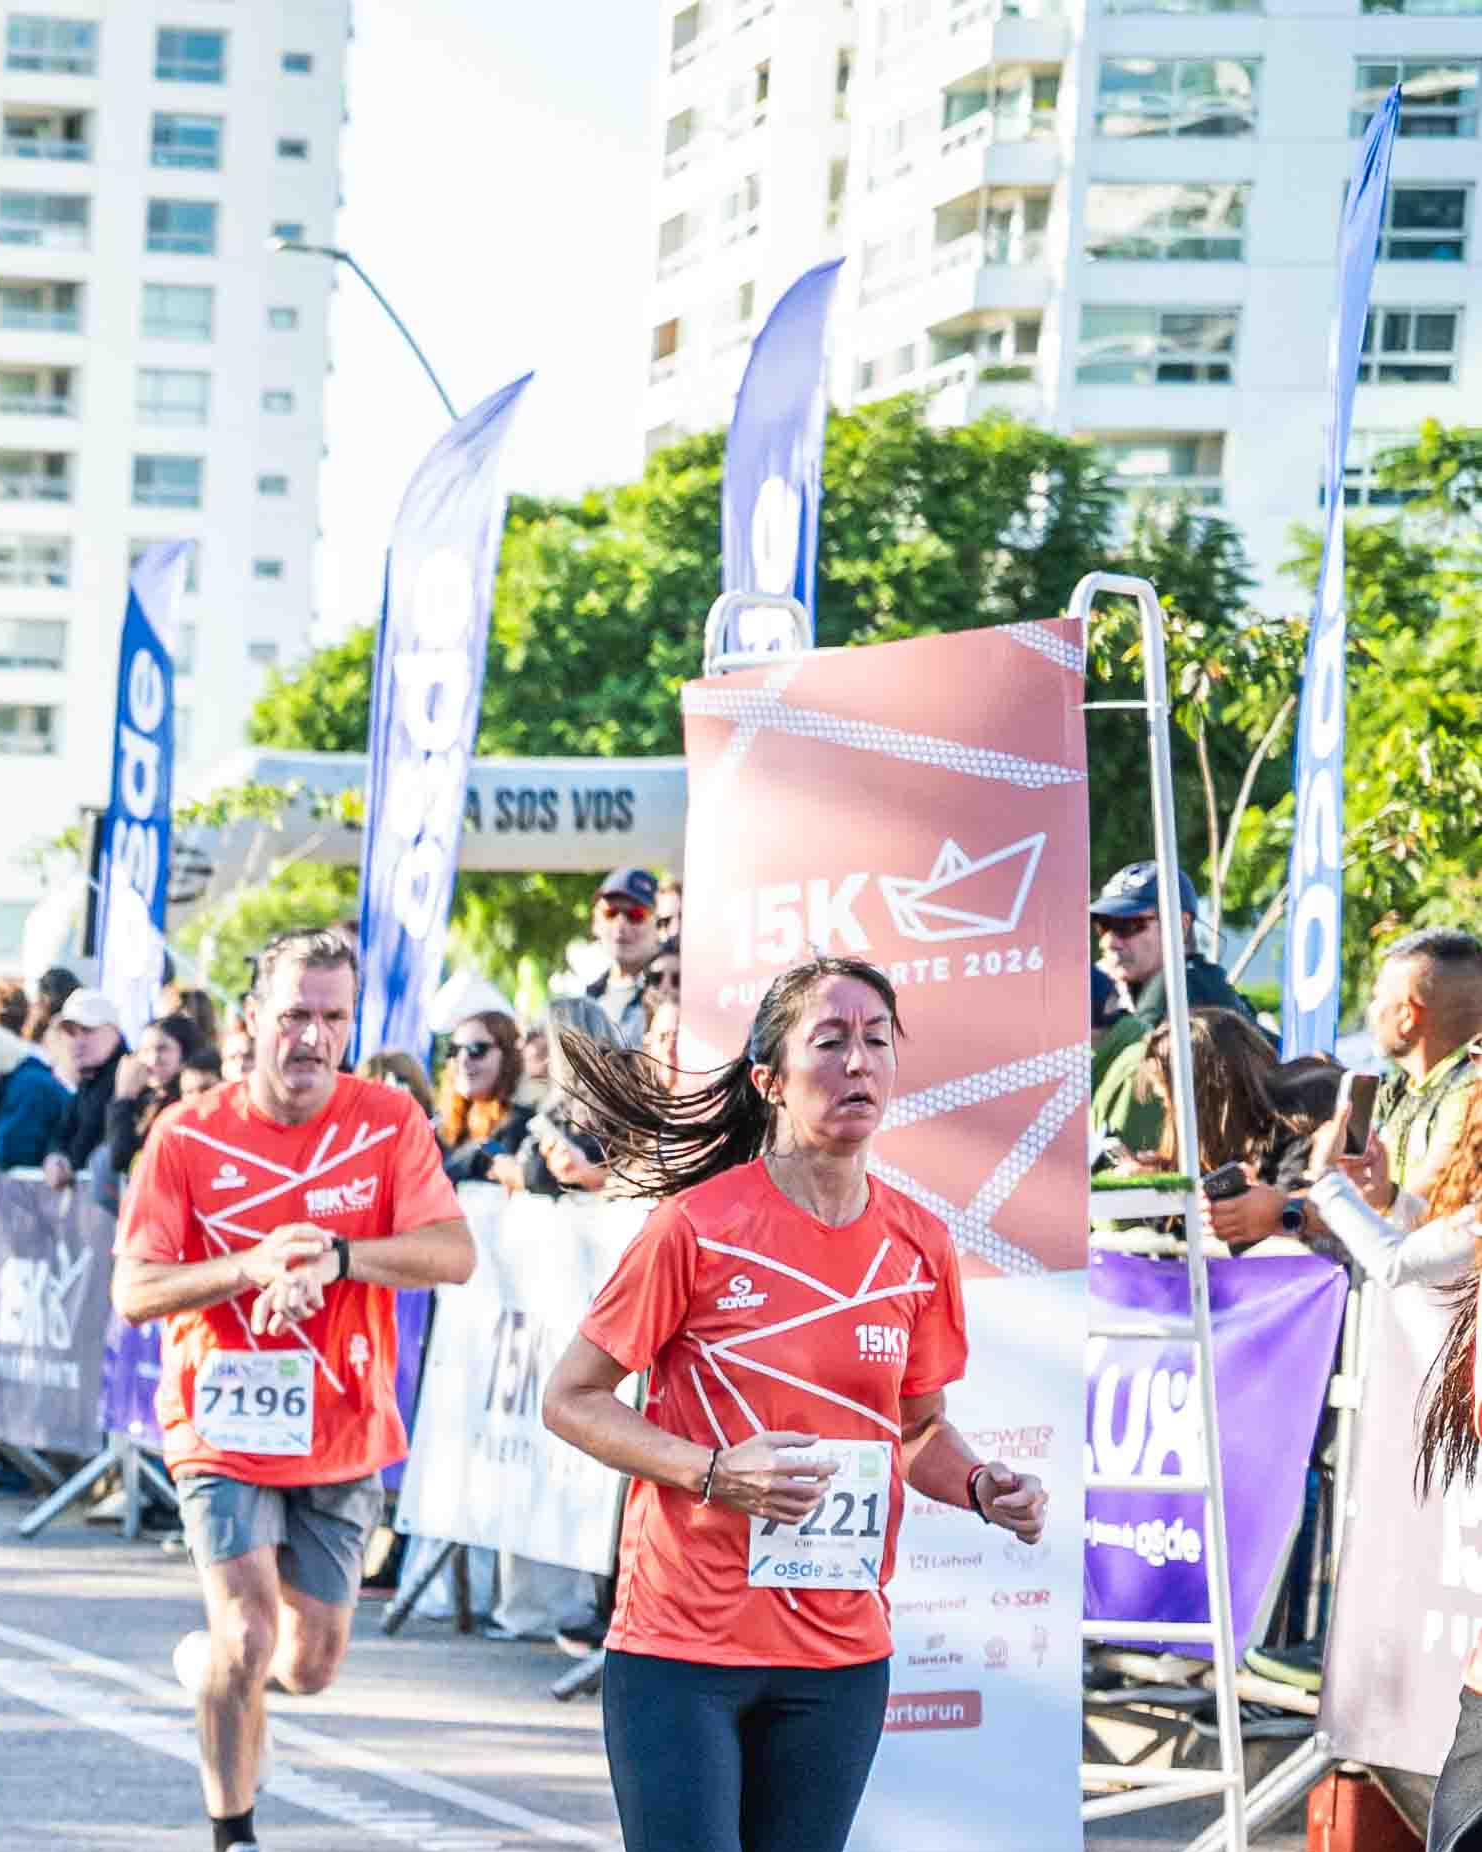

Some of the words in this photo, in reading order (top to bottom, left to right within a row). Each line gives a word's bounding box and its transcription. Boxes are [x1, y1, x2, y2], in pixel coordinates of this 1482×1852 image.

[112, 647, 166, 910] sde
[495, 785, 559, 834] SOS
[570, 785, 635, 834] VOS
[963, 947, 1045, 978] 2026
[855, 1323, 901, 1353] 15K
[201, 1386, 307, 1418] 7196
[774, 1560, 824, 1580] osde
[885, 1702, 964, 1724] orterun
